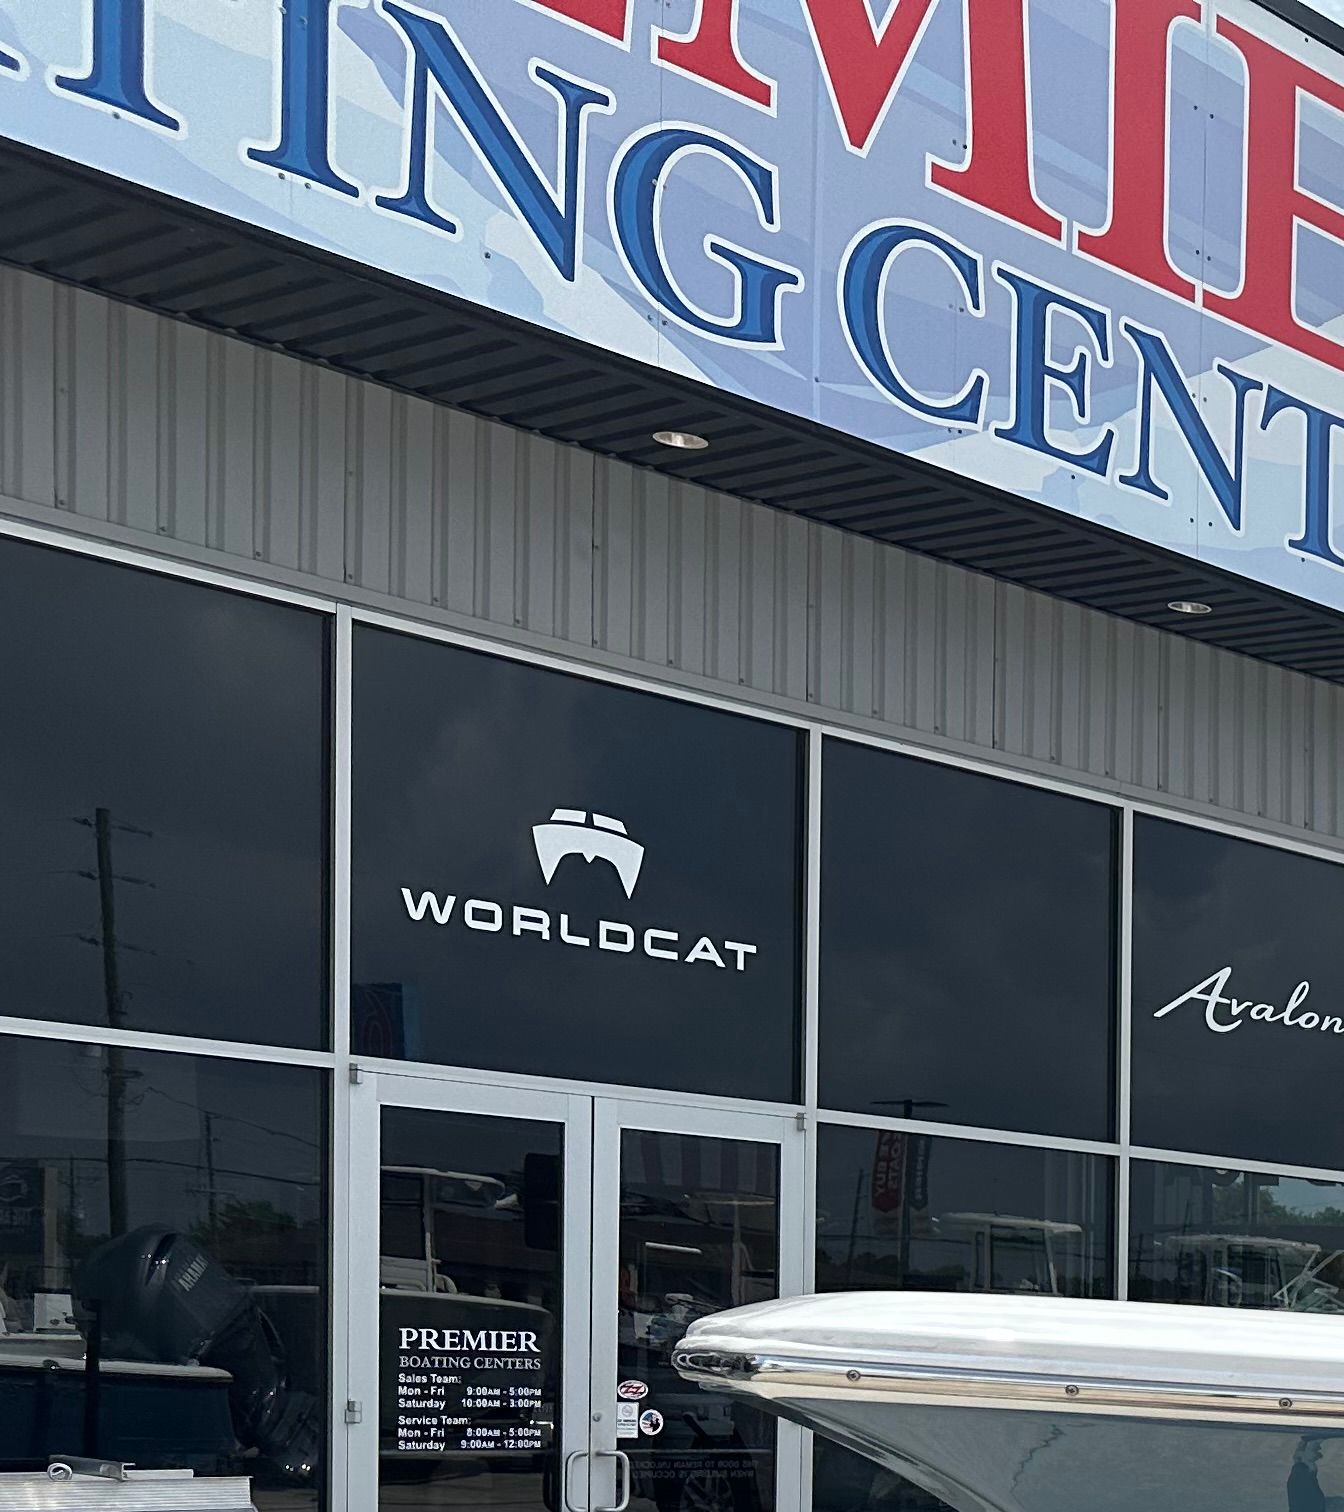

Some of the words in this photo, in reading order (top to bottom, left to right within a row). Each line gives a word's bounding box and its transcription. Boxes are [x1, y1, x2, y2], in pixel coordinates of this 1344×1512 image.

[401, 887, 757, 971] WORLDCAT
[1153, 966, 1344, 1033] Avalon
[398, 1327, 542, 1353] PREMIER
[399, 1355, 471, 1369] BOATING
[474, 1357, 541, 1371] CENTERS
[398, 1373, 428, 1384] Sales
[430, 1373, 462, 1384] Team:
[398, 1386, 421, 1396] Mon
[430, 1386, 445, 1396] Fri
[466, 1387, 500, 1396] 9:00AM
[509, 1387, 542, 1396] 5:00PM
[398, 1398, 446, 1410] Saturday
[461, 1399, 500, 1408] 10:00AM
[398, 1415, 438, 1425] Service
[440, 1416, 472, 1425] Team:
[398, 1428, 421, 1437] Mon
[430, 1428, 445, 1437] Fri
[508, 1428, 542, 1437] 5:00PM
[398, 1440, 446, 1451] Saturday
